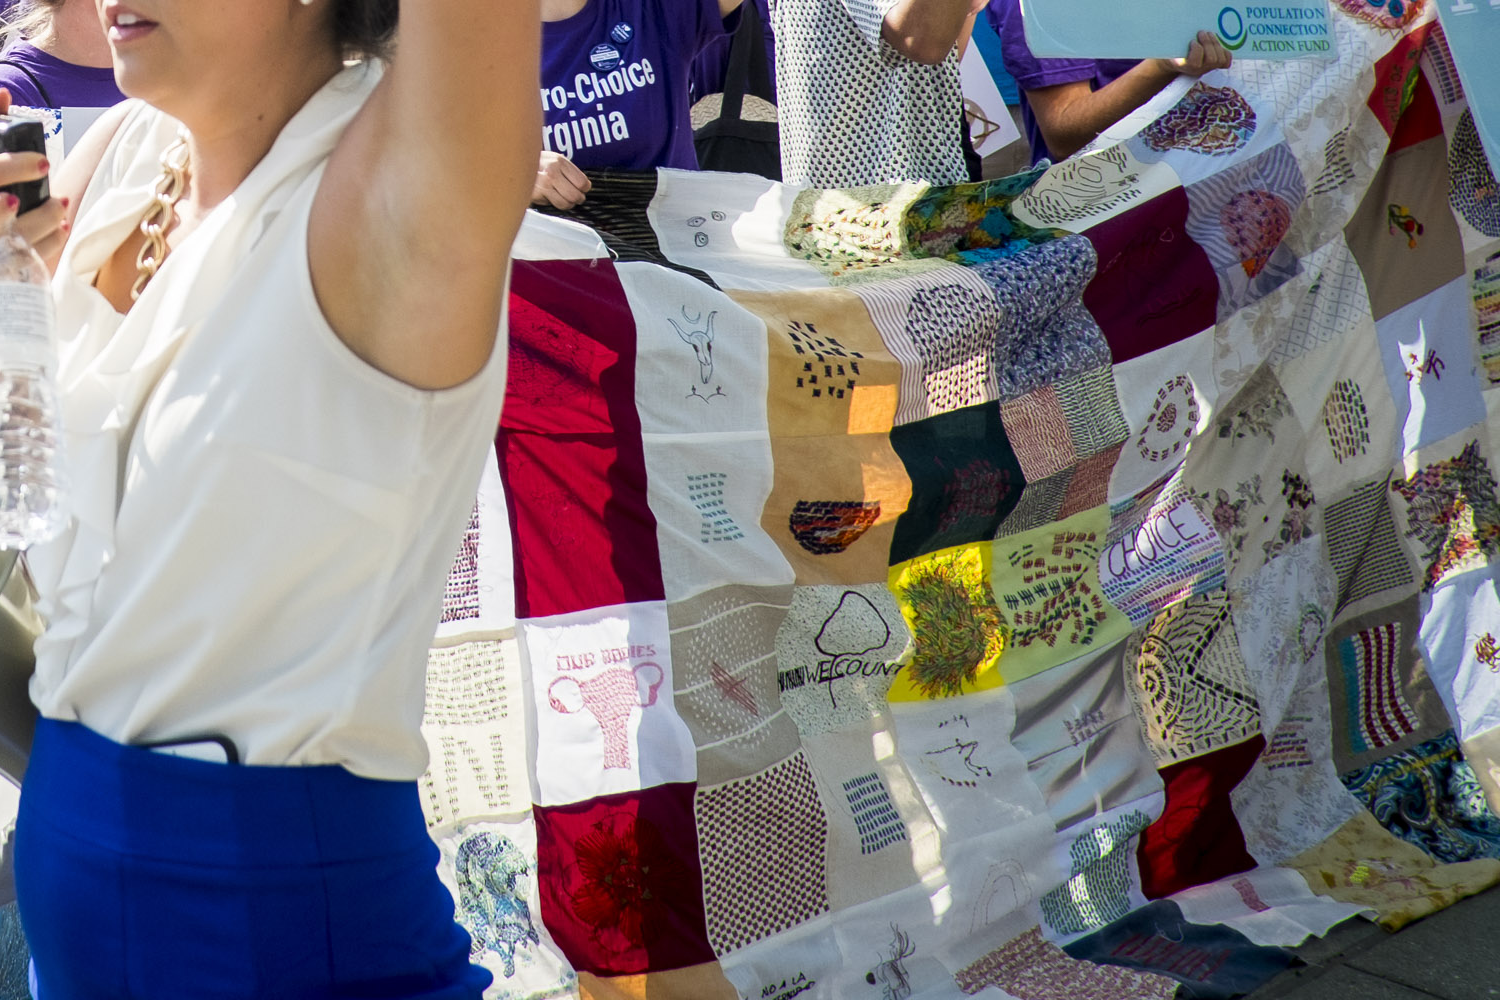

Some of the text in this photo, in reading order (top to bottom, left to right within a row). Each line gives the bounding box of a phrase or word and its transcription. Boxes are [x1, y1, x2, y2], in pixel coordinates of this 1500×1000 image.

[1246, 6, 1325, 21] POPULATION
[1249, 22, 1328, 36] CONNECTION
[1251, 38, 1331, 52] ACTION FUND
[540, 57, 656, 112] ro-Choice
[542, 103, 630, 162] rginia
[1107, 504, 1200, 580] CHOICE
[556, 652, 595, 671] OUR
[761, 984, 776, 998] NO
[792, 971, 806, 985] LA
